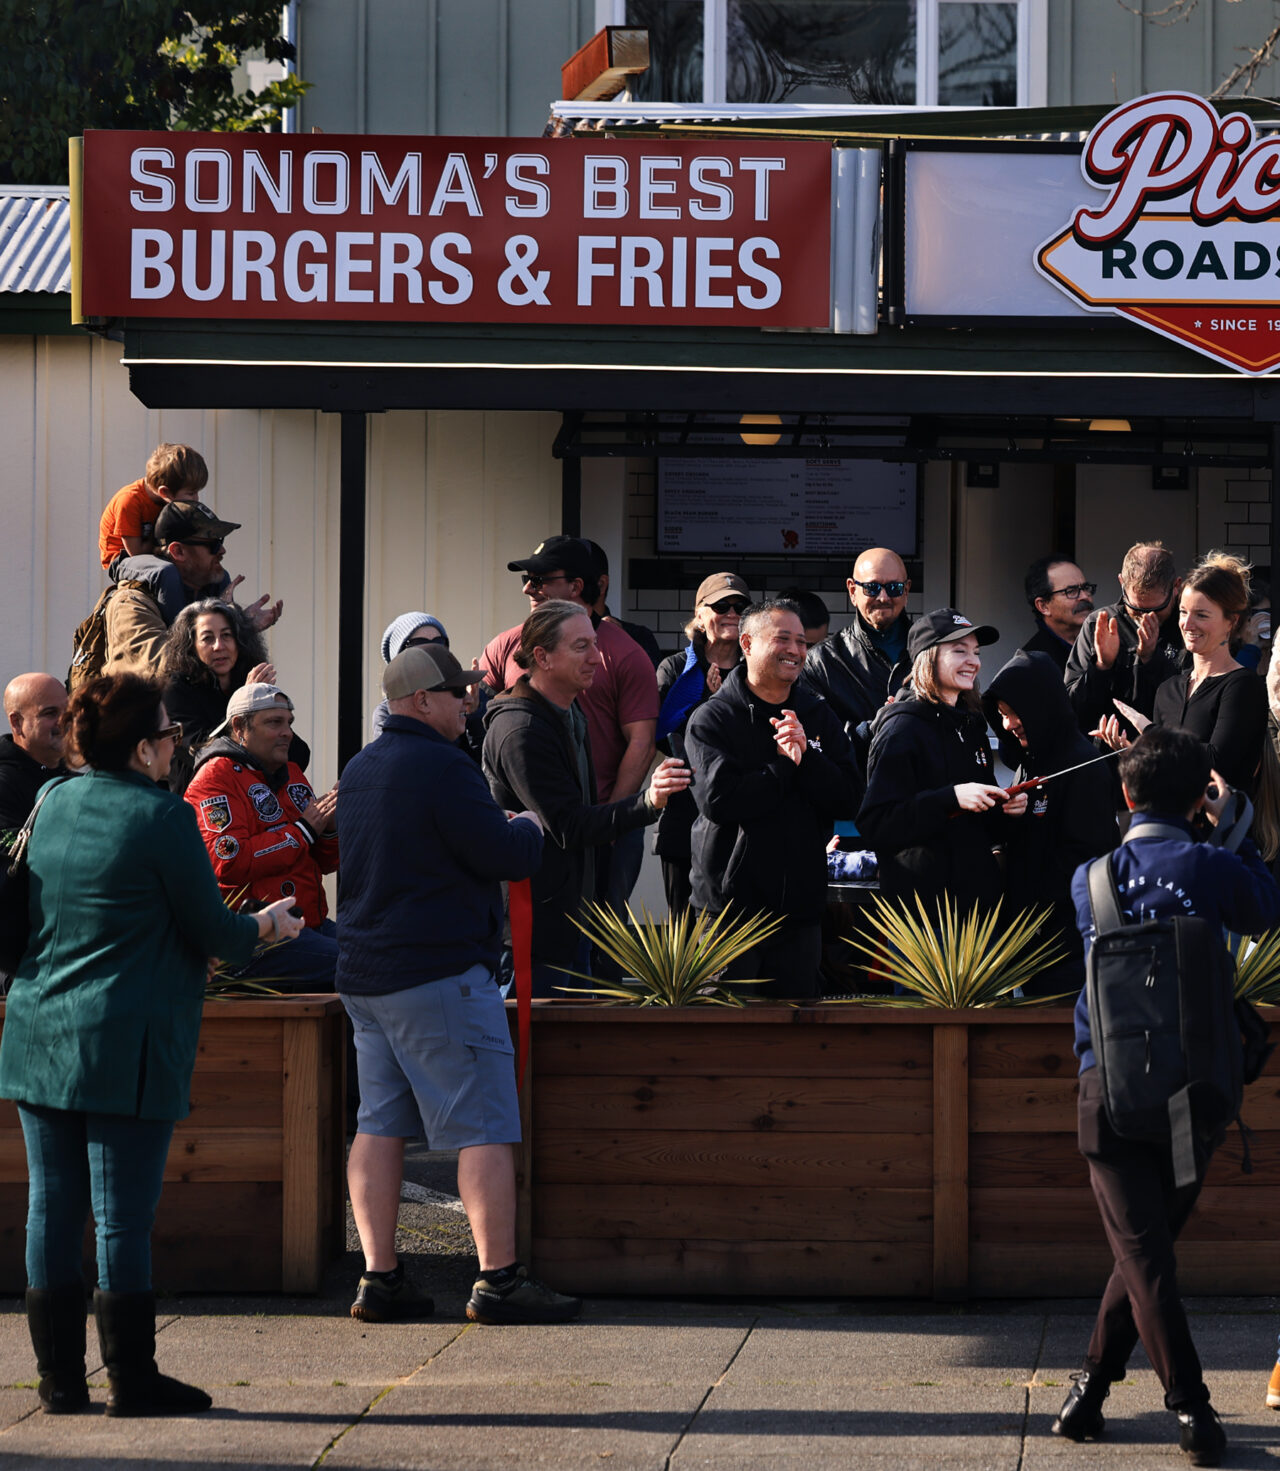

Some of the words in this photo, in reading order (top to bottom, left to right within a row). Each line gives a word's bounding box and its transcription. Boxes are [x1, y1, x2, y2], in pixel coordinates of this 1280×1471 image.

[130, 148, 551, 218] SONOMA'S
[584, 155, 786, 221] BEST
[131, 229, 474, 305] BURGERS
[498, 234, 552, 306] &
[578, 236, 783, 310] FRIES
[1210, 319, 1258, 332] SINCE
[1118, 875, 1146, 893] ERS
[1156, 876, 1196, 916] LANDI
